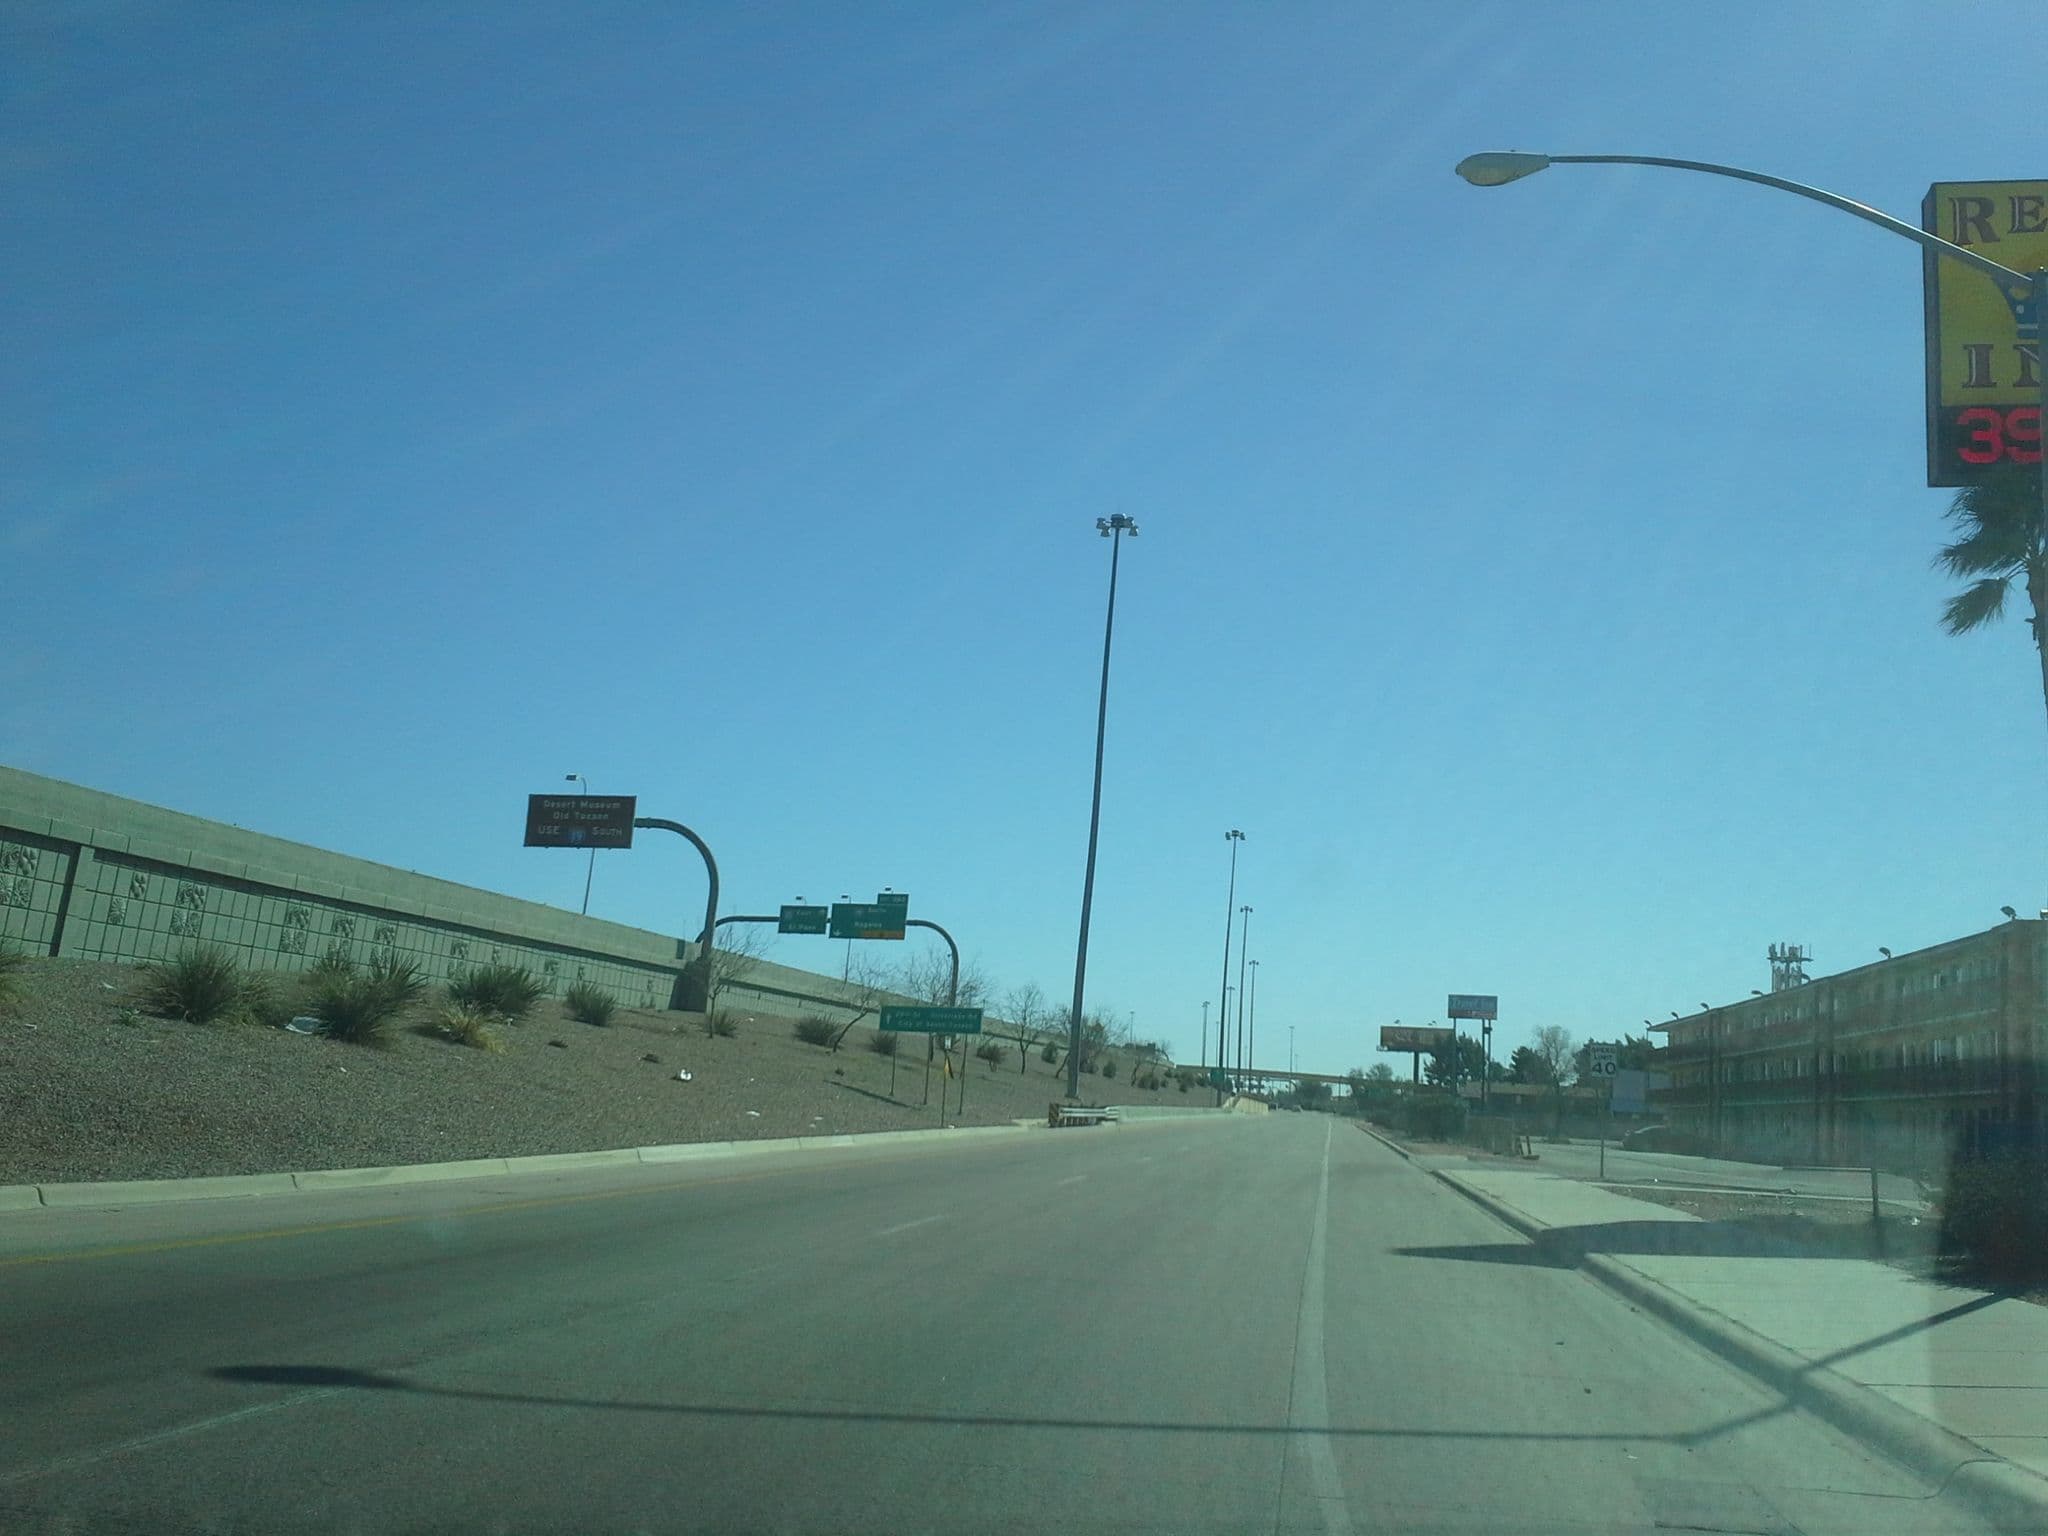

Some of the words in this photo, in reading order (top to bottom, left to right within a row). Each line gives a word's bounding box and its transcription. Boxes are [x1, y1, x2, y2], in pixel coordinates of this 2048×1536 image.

[543, 800, 576, 809] Desert
[580, 800, 621, 809] Museum
[538, 825, 560, 834] USE
[1591, 1062, 1616, 1075] 40
